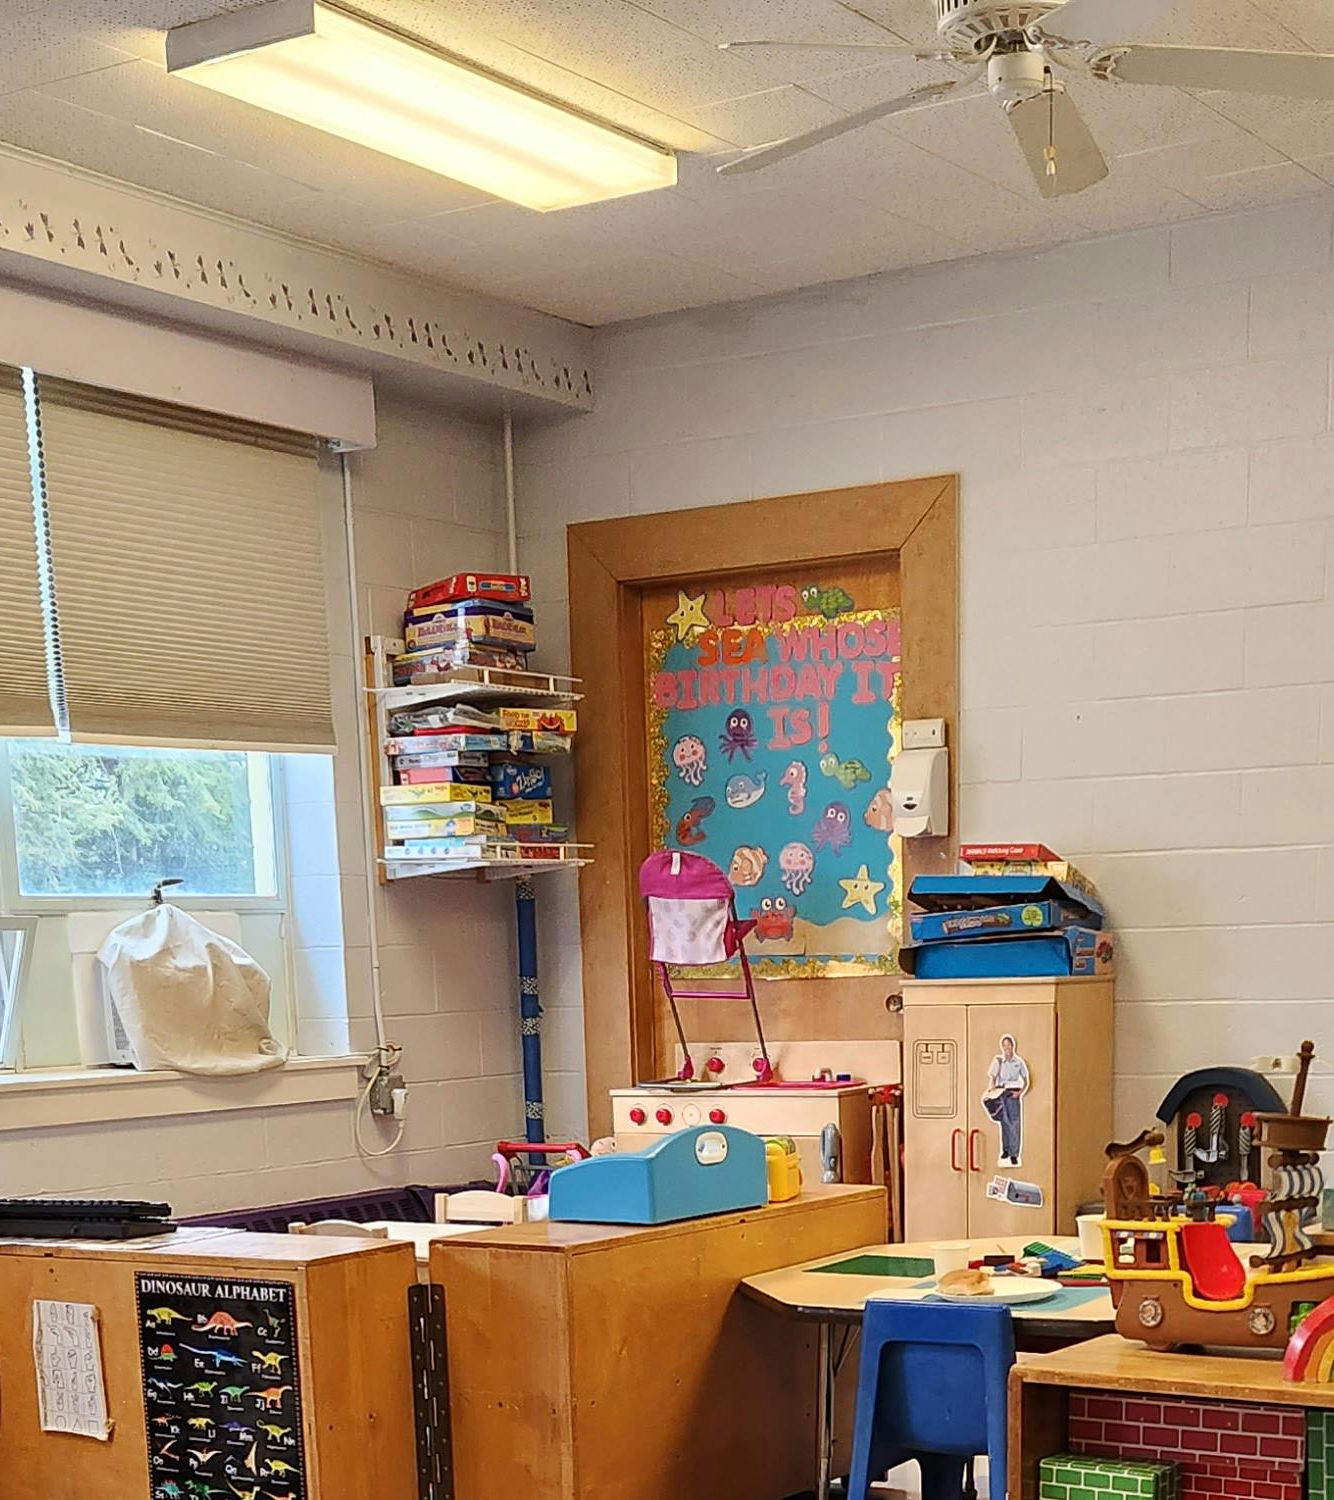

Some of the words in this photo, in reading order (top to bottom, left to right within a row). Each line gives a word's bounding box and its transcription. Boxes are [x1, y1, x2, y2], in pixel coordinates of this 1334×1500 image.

[714, 584, 797, 627] LETS
[697, 628, 768, 666] SEA
[654, 661, 843, 709] BIRTHDAY
[851, 659, 901, 704] IT
[767, 701, 832, 753] IS!
[141, 1279, 212, 1298] DINOSAUR
[214, 1285, 287, 1302] ALPHABET
